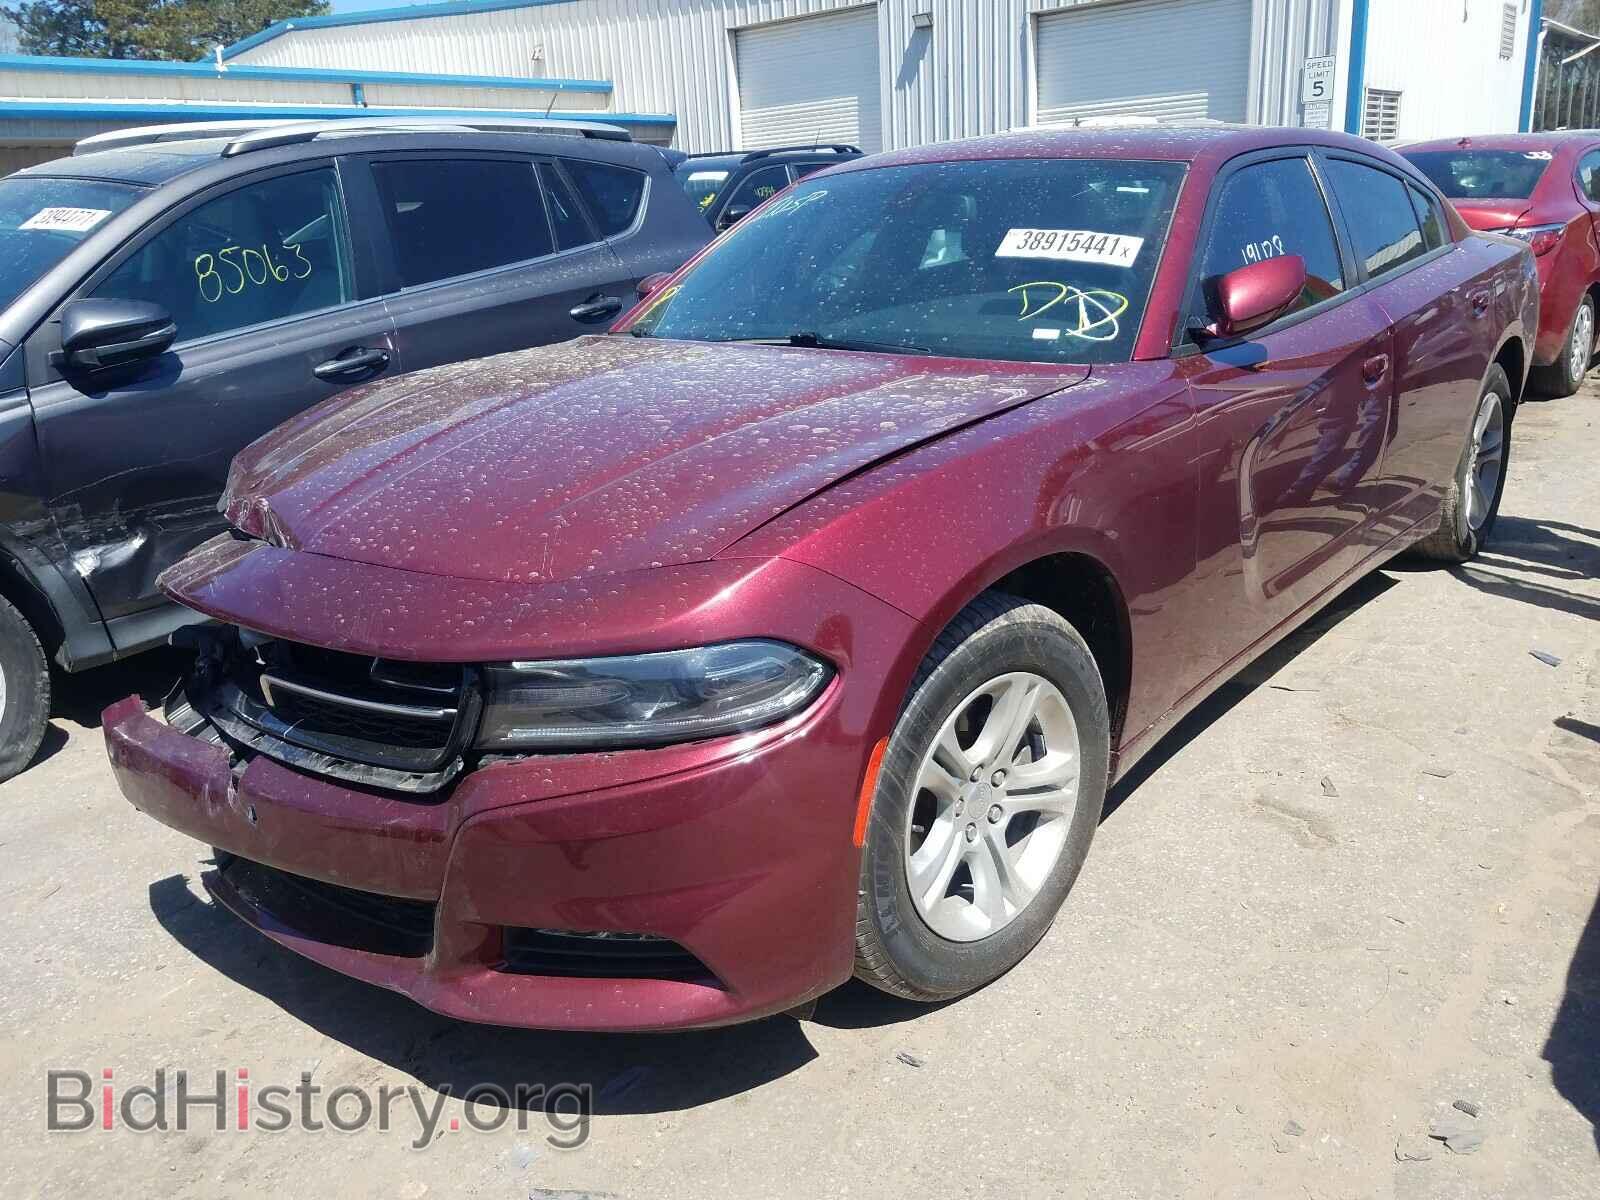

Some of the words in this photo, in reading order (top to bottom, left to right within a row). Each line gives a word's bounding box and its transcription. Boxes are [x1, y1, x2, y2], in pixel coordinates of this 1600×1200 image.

[1306, 60, 1333, 70] SPEED
[1308, 70, 1330, 79] LIMIT
[1312, 80, 1324, 97] 5
[194, 243, 312, 303] 85063
